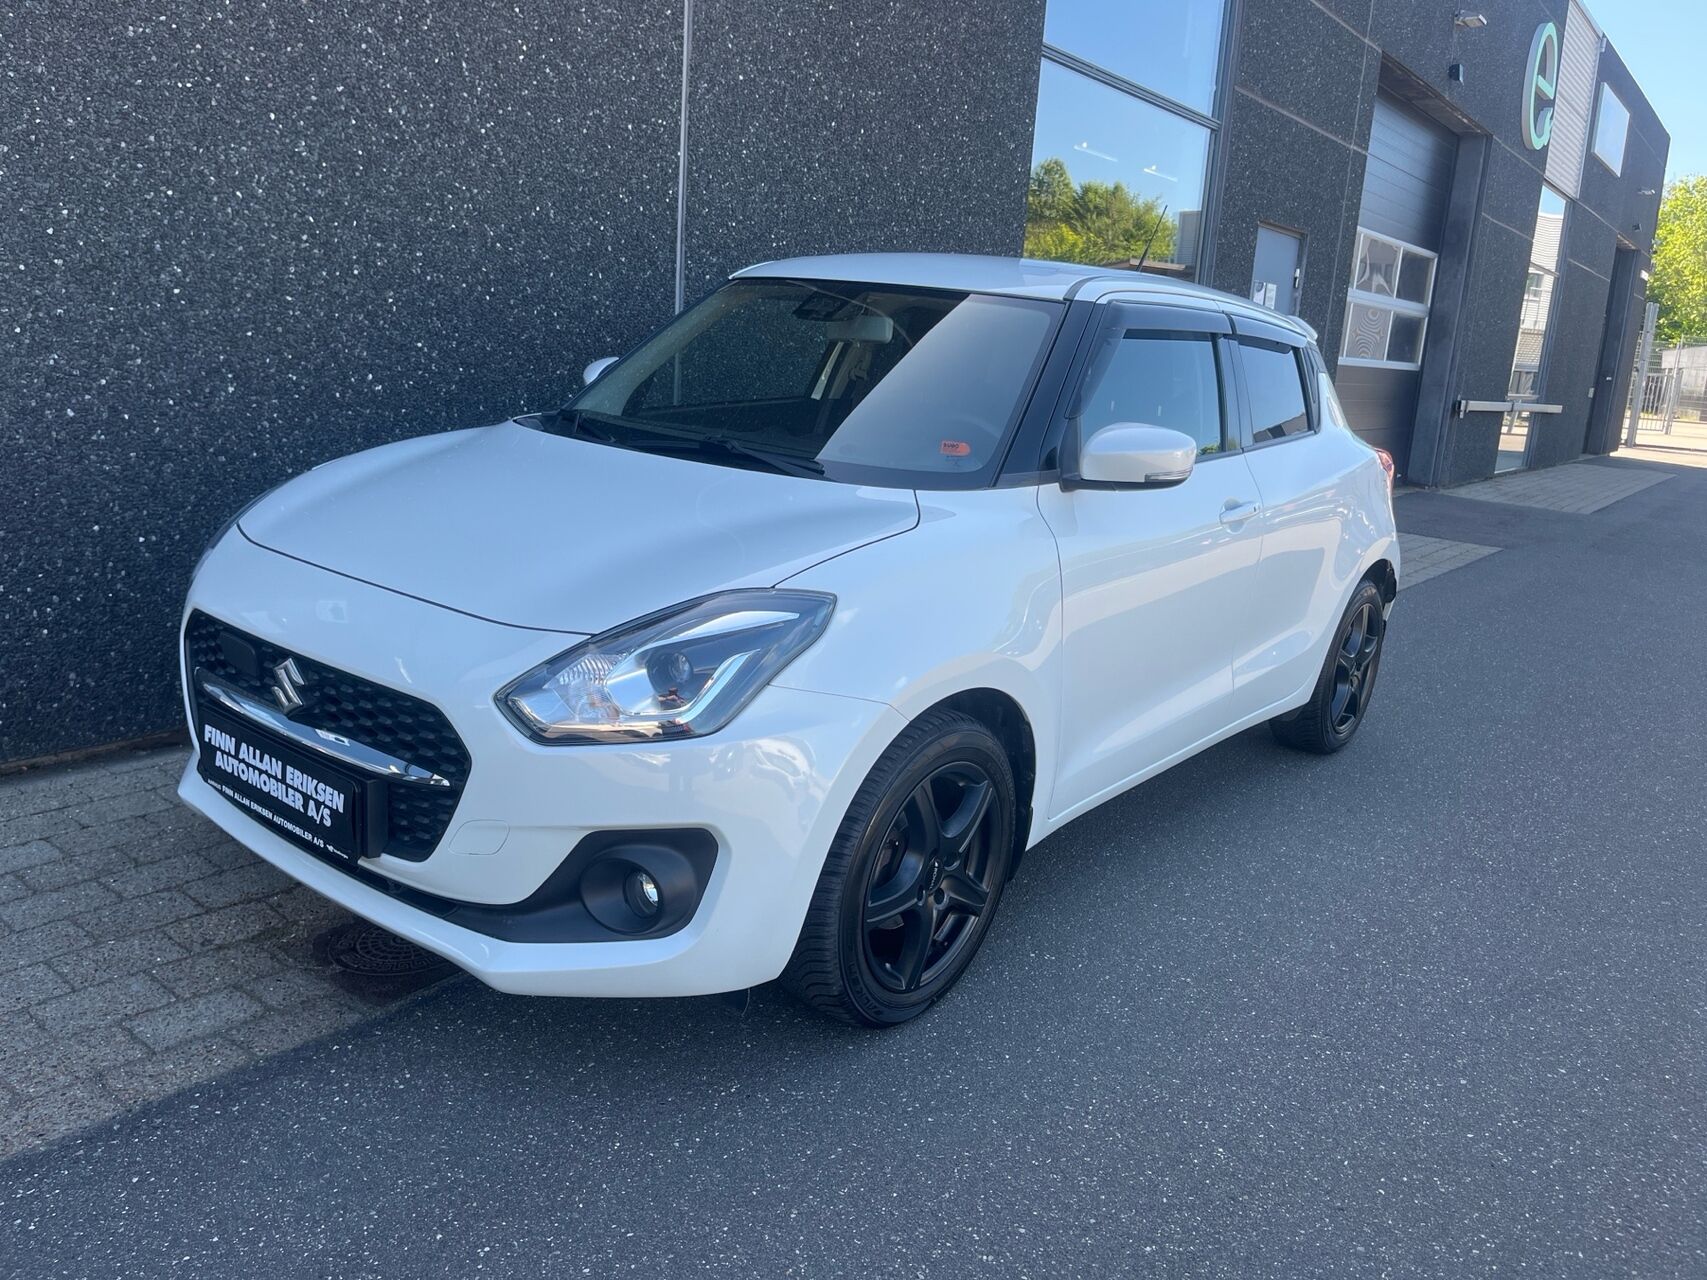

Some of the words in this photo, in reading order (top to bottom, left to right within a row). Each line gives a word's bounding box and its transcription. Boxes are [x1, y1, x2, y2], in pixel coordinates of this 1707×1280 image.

[204, 723, 236, 755] FINN
[239, 742, 282, 779] ALLAN
[286, 765, 345, 813] ERIKSEN
[215, 750, 304, 813] AUTOMOBILER
[307, 799, 332, 827] A/S
[222, 785, 234, 798] FINN
[234, 792, 251, 807] ALLAN
[250, 801, 273, 820] ERIKSEN
[273, 814, 313, 842] AUTOMOBILER
[313, 836, 325, 848] A/S
